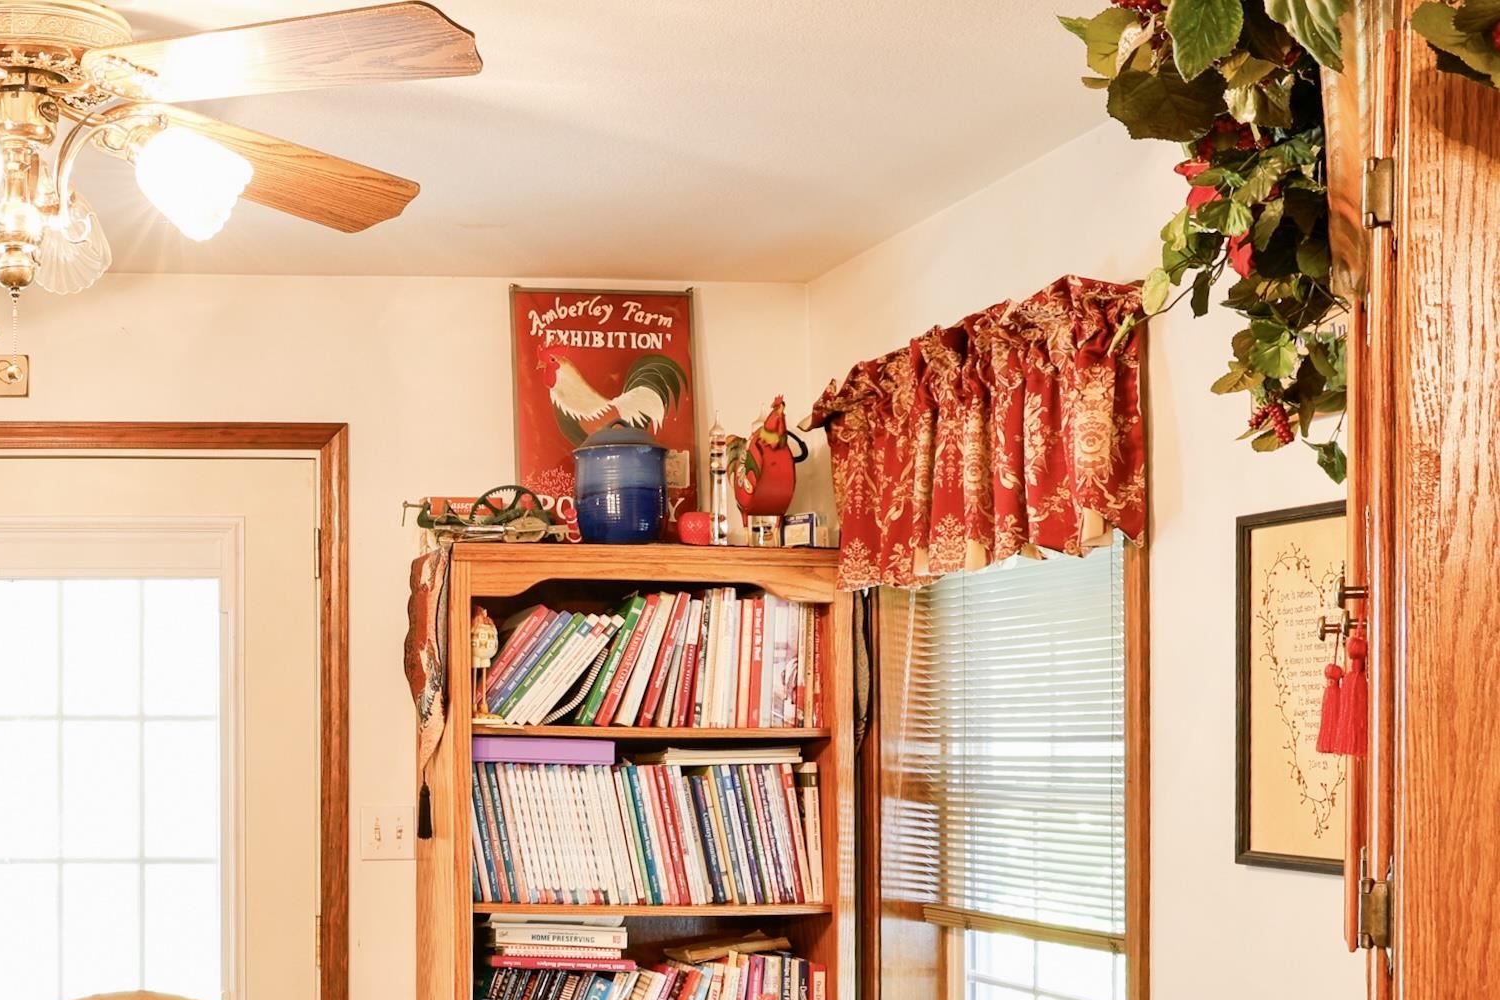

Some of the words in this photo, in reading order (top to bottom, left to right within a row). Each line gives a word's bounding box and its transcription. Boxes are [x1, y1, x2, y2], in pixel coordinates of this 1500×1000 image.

[528, 295, 614, 336] Amberley
[622, 301, 673, 328] Farm
[531, 934, 550, 942] HOME
[551, 935, 595, 944] PRESERVING
